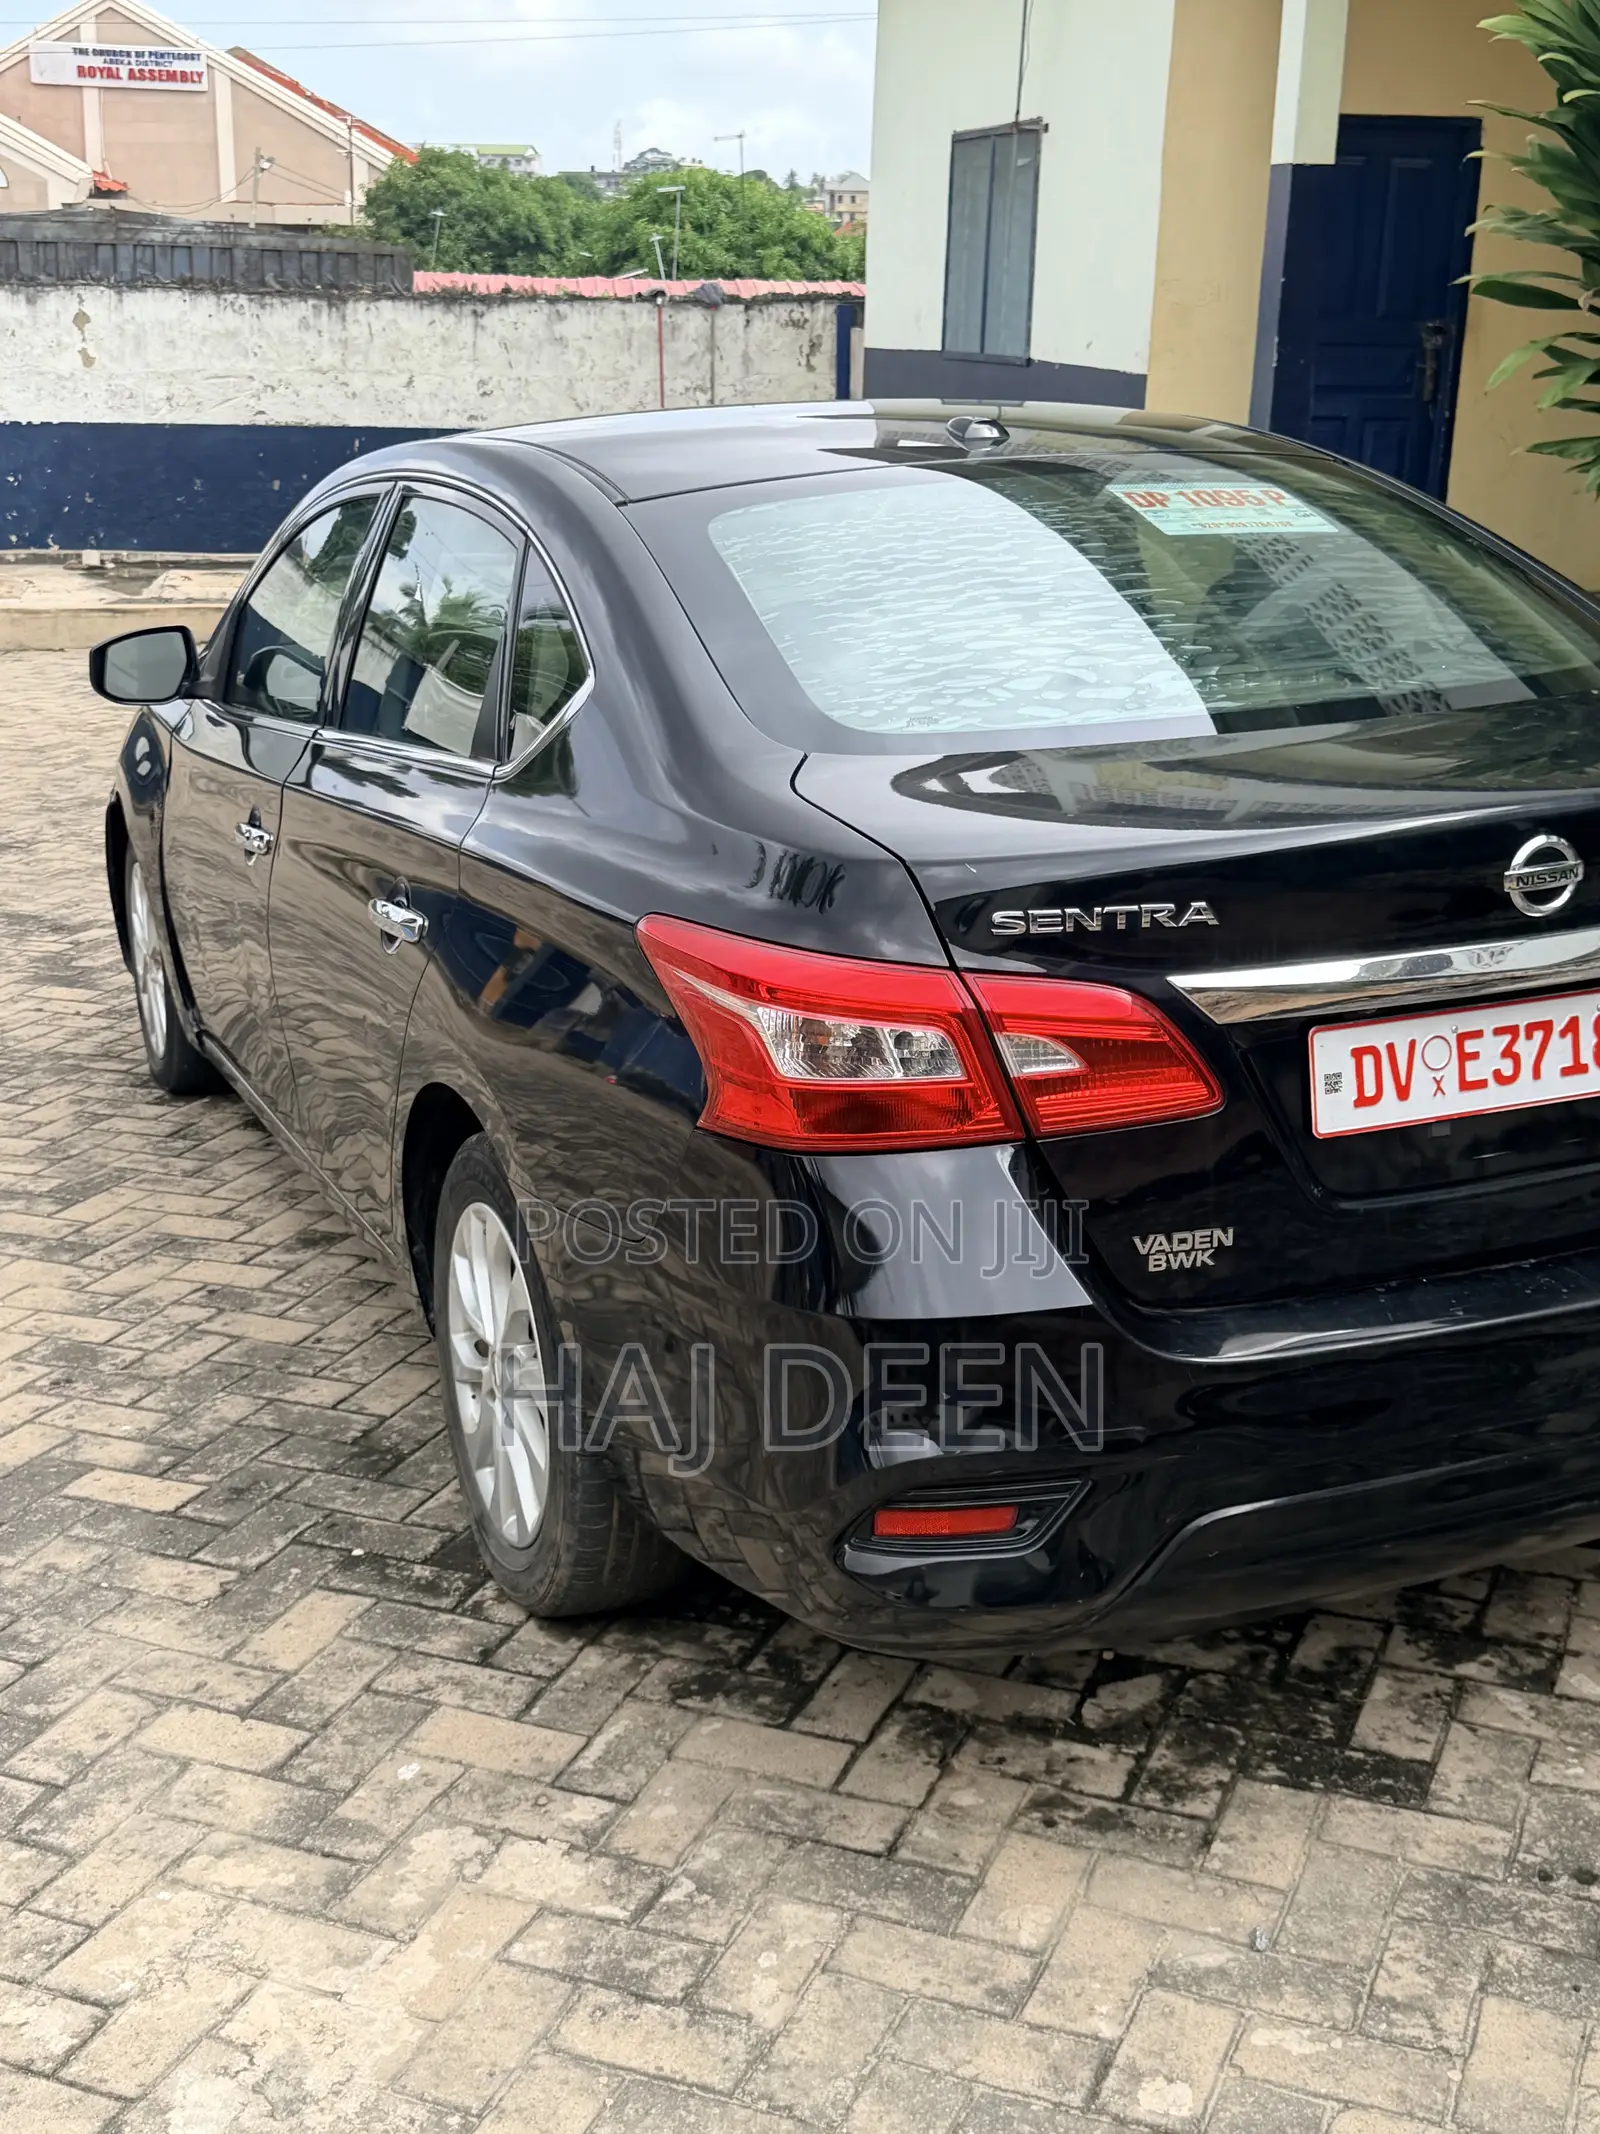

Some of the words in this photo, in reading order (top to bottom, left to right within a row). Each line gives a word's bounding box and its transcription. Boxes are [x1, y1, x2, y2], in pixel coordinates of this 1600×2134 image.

[72, 47, 90, 56] THE
[92, 48, 132, 58] CHURCH
[135, 50, 145, 58] OF
[148, 50, 201, 61] PENTECOST
[135, 59, 174, 68] DISTRICT
[76, 65, 123, 80] ROYAL
[128, 68, 204, 84] ASSEMBLY
[1515, 867, 1579, 887] NISSAN
[990, 901, 1220, 936] SENTRA
[1350, 1038, 1417, 1108] DV
[1455, 1013, 1600, 1092] E371
[1132, 1226, 1234, 1255] VADEN
[1148, 1249, 1215, 1272] BWK
